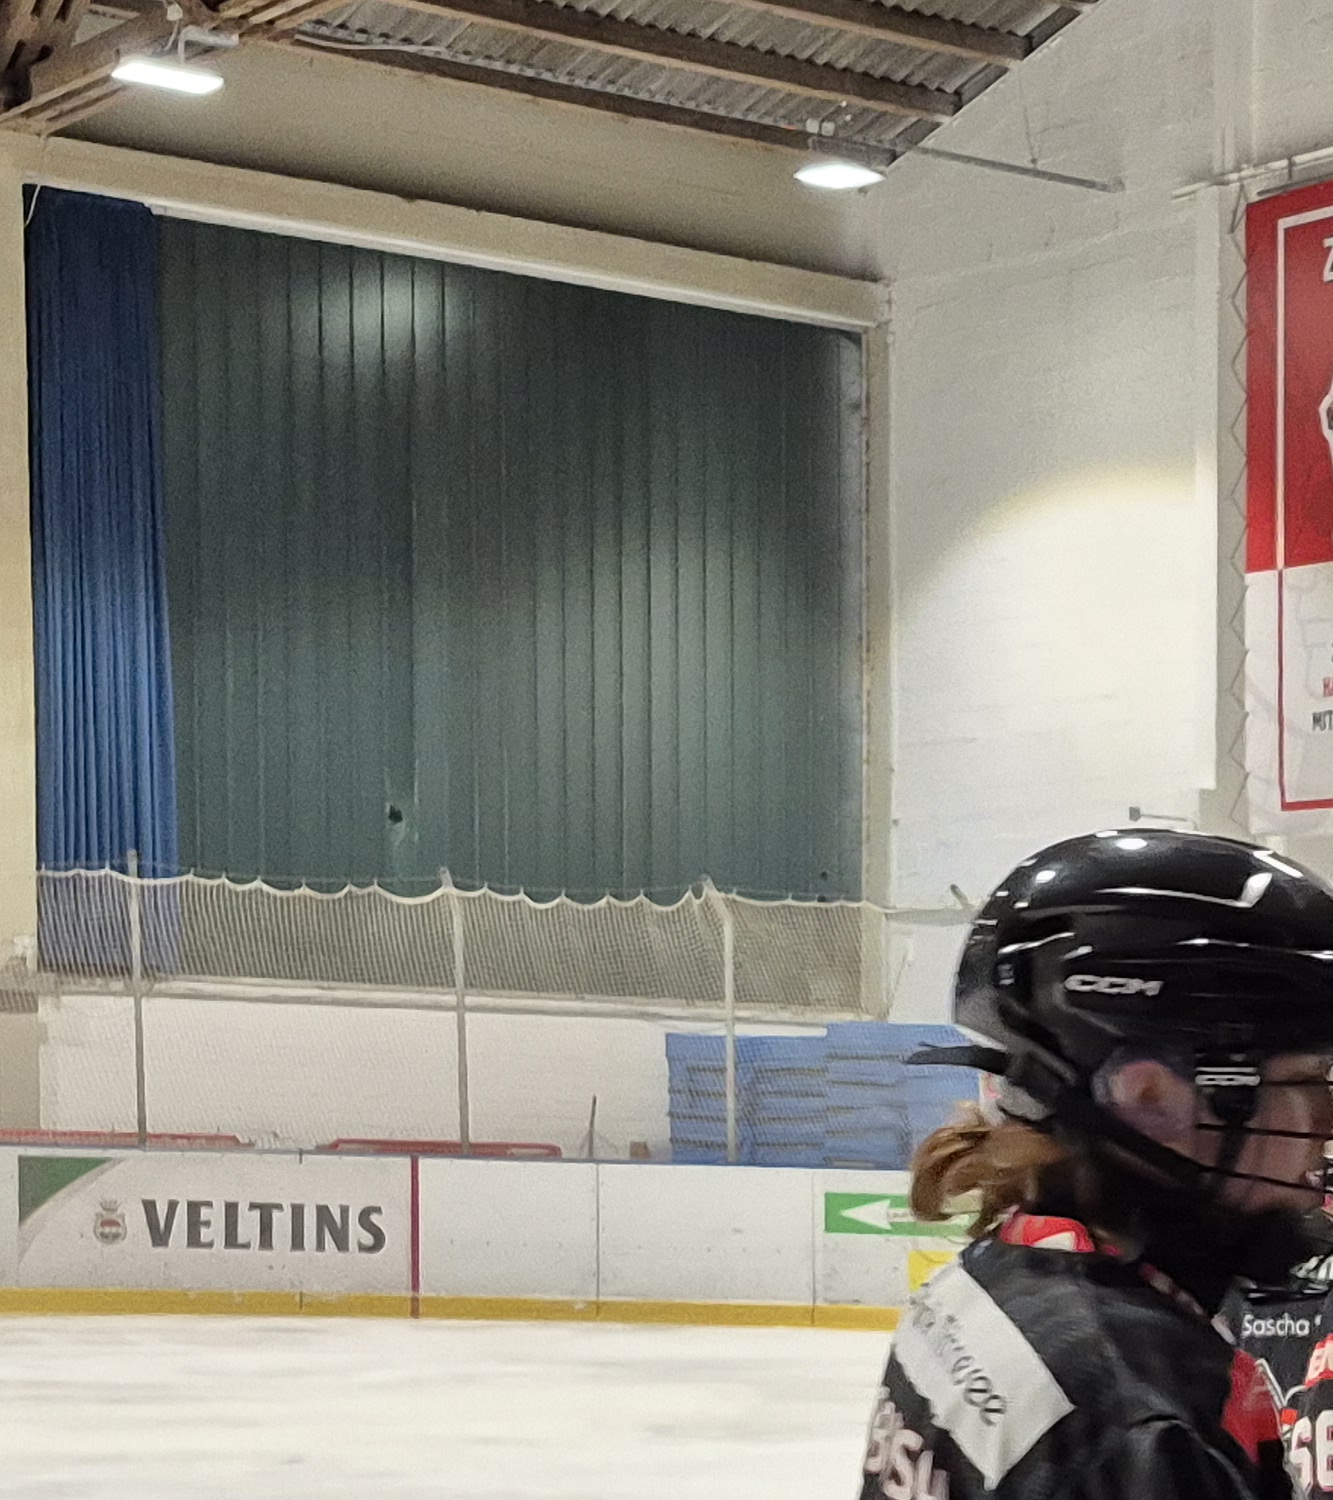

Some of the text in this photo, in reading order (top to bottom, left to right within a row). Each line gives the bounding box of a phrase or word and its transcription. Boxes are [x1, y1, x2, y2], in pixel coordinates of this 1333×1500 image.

[1312, 709, 1333, 731] MIT
[142, 1198, 387, 1254] VELTINS
[1241, 1313, 1310, 1337] Sascha
